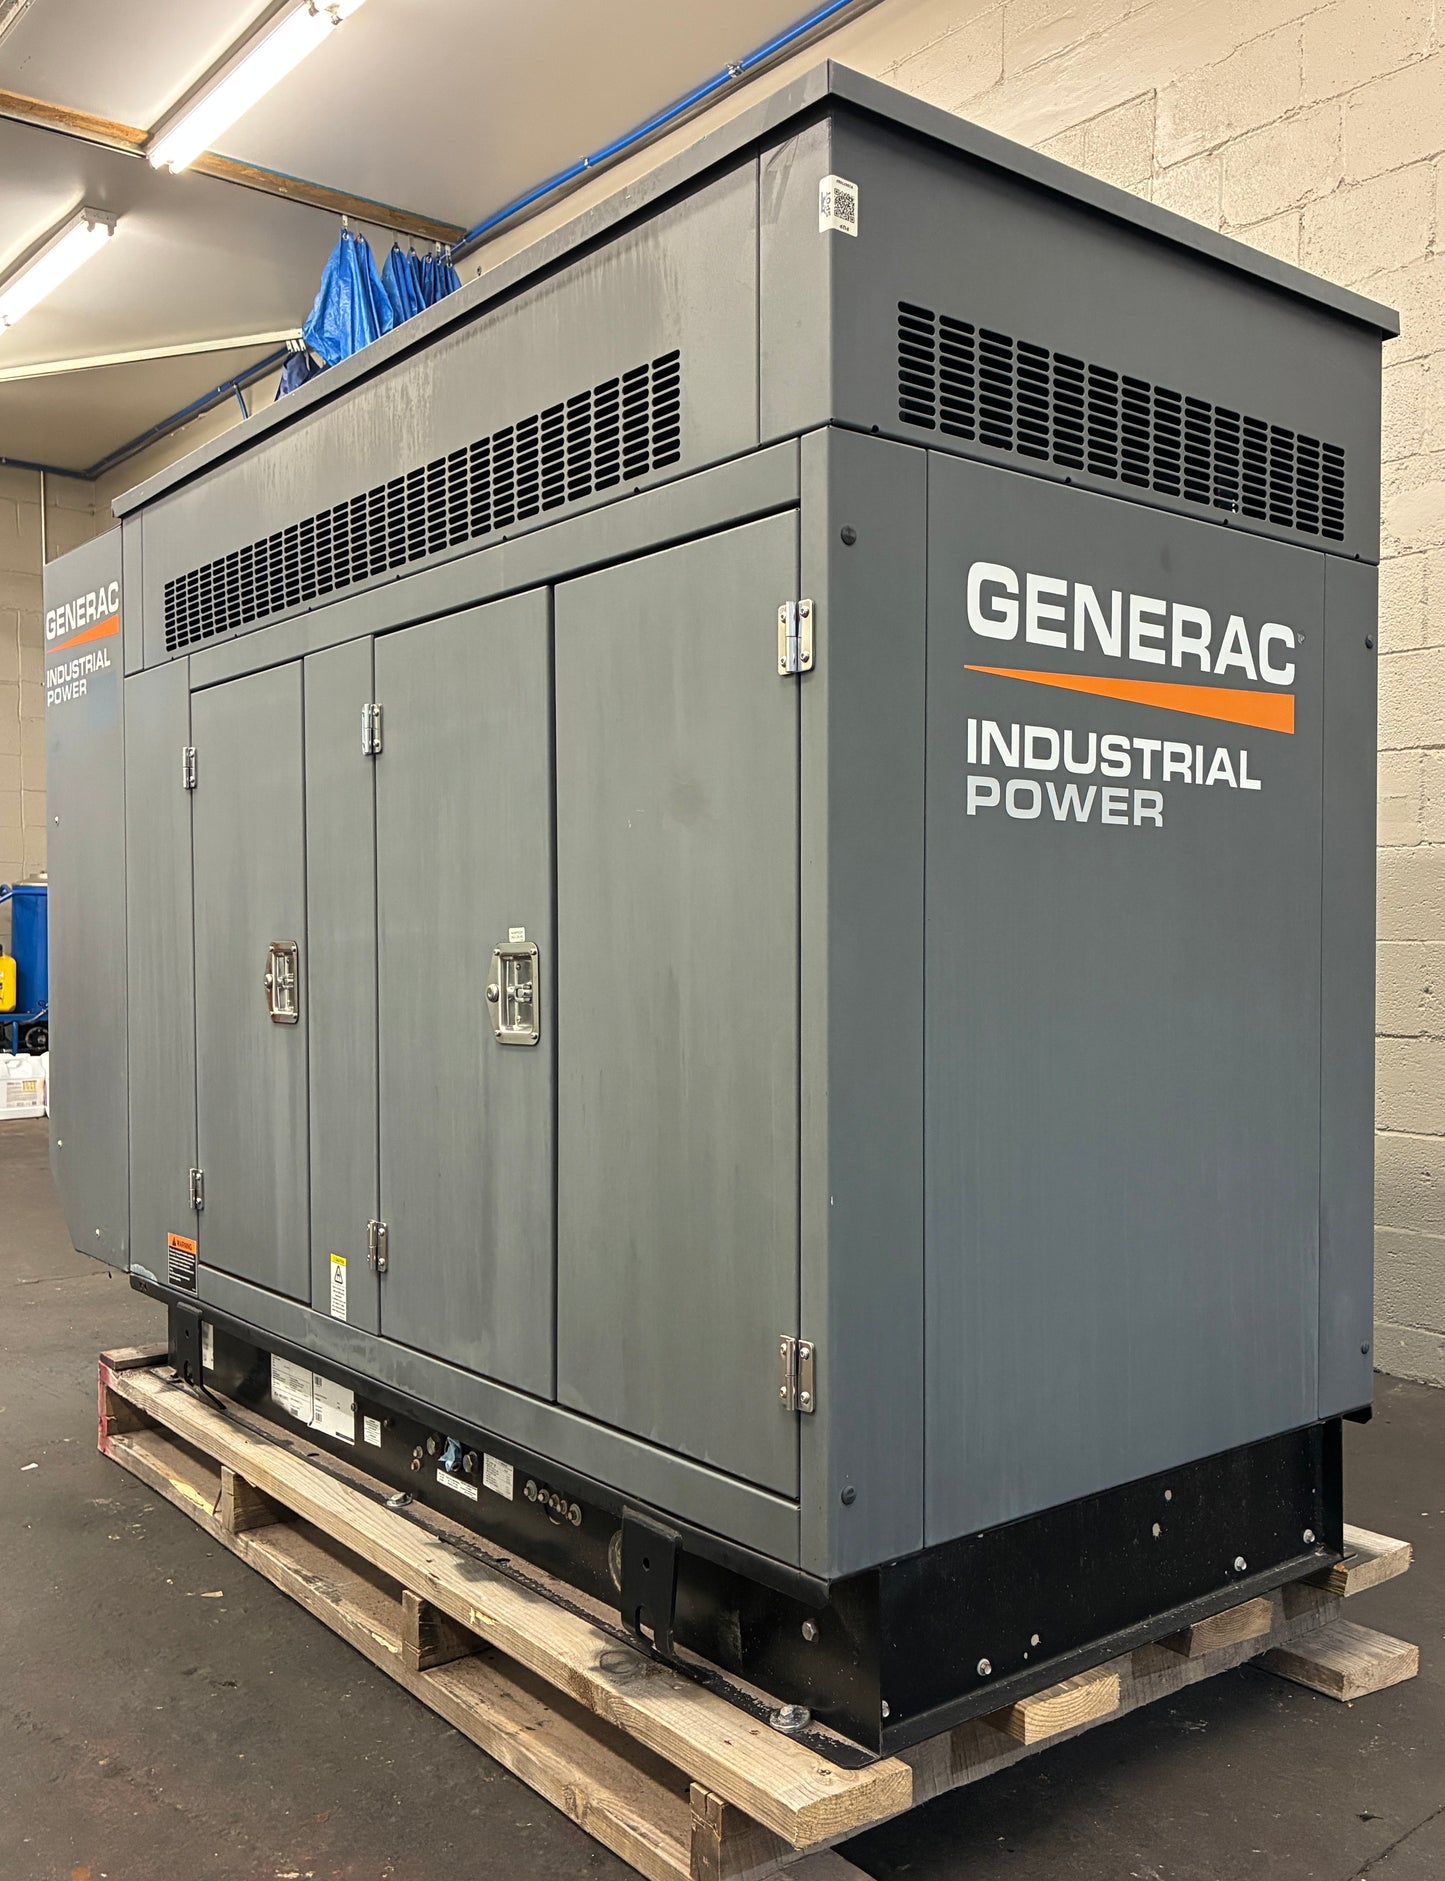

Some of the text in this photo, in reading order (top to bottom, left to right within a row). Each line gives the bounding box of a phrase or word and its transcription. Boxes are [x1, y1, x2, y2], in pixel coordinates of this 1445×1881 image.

[45, 580, 120, 641] GENERAC
[966, 561, 1297, 687] GENERAC
[47, 647, 112, 690] INDUSTRIAL
[47, 678, 88, 708] POWER
[966, 718, 1263, 792] INDUSTRIAL
[966, 774, 1165, 827] POWER
